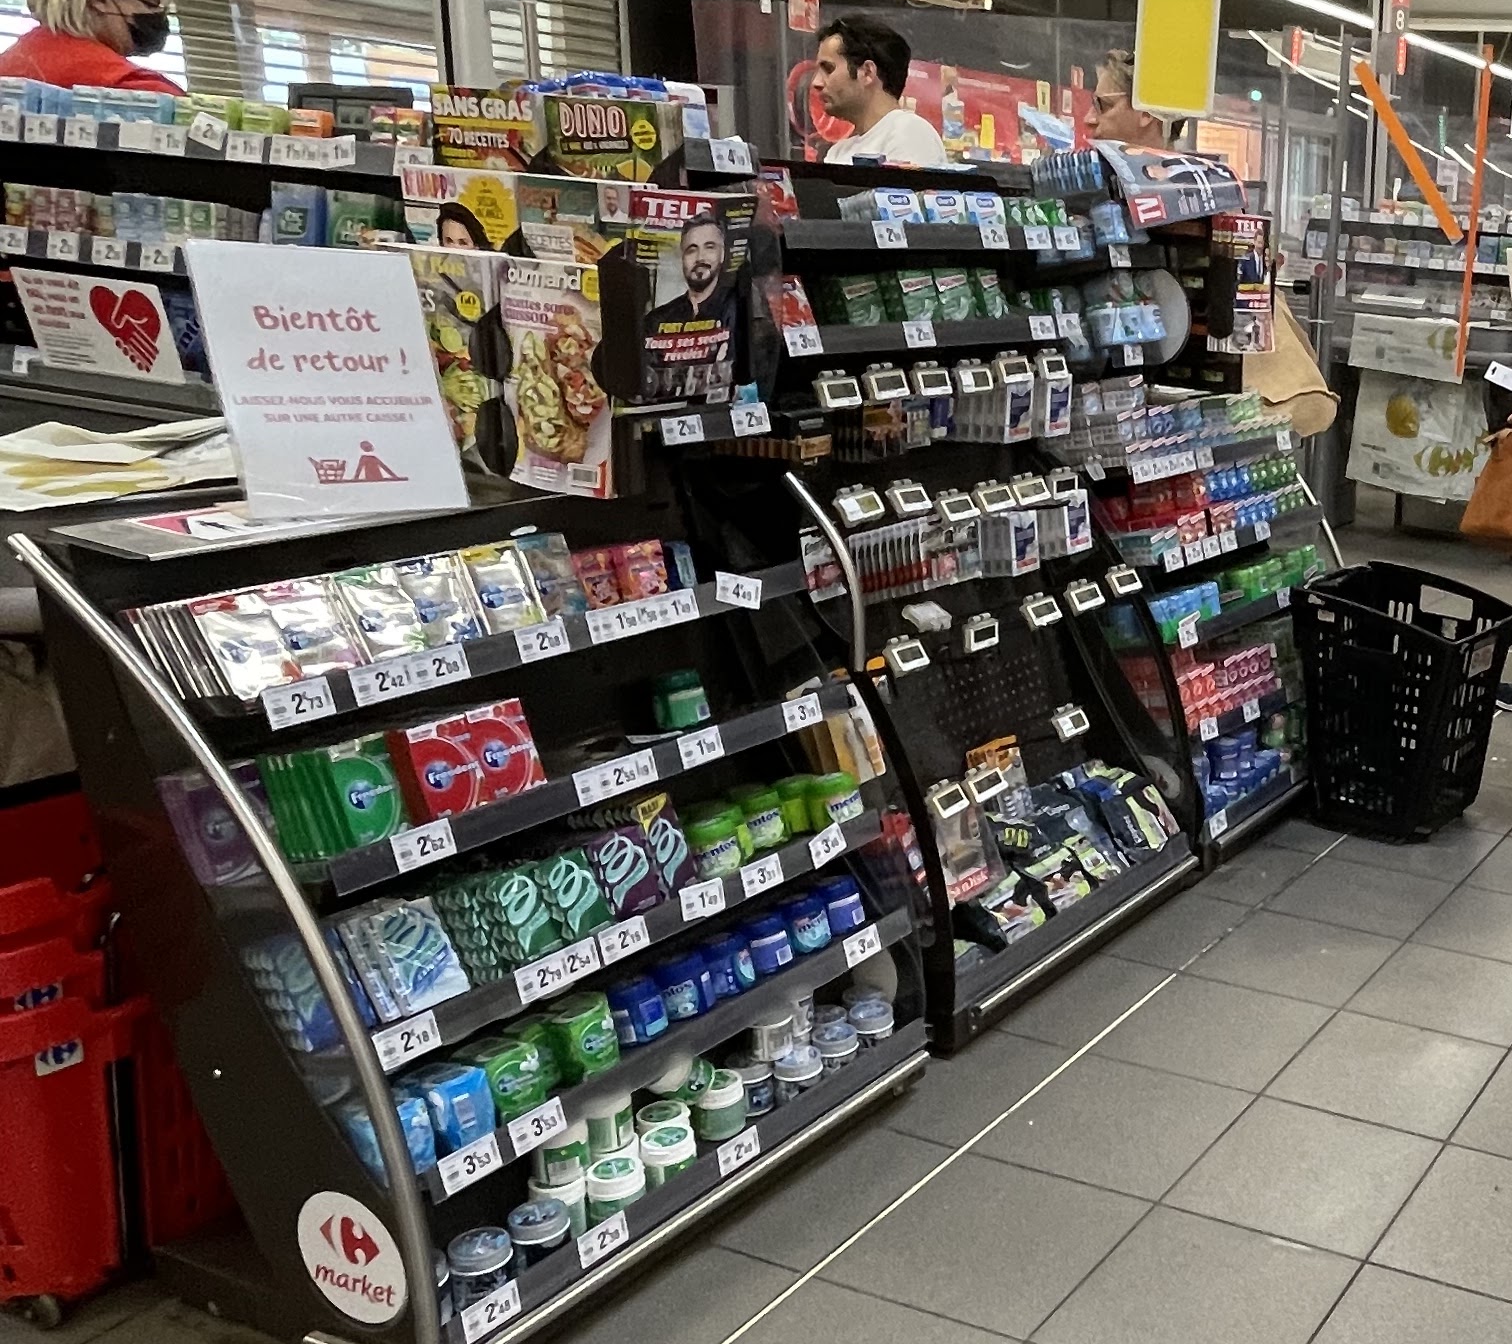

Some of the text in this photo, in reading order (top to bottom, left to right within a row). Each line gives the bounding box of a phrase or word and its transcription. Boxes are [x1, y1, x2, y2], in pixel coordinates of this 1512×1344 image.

[1396, 9, 1405, 31] 8
[432, 93, 534, 122] SANS GRAS
[558, 102, 628, 138] DINO
[507, 267, 582, 290] ourmand
[253, 305, 381, 333] Bientôt
[247, 348, 410, 374] de retour !
[315, 1264, 396, 1307] market
